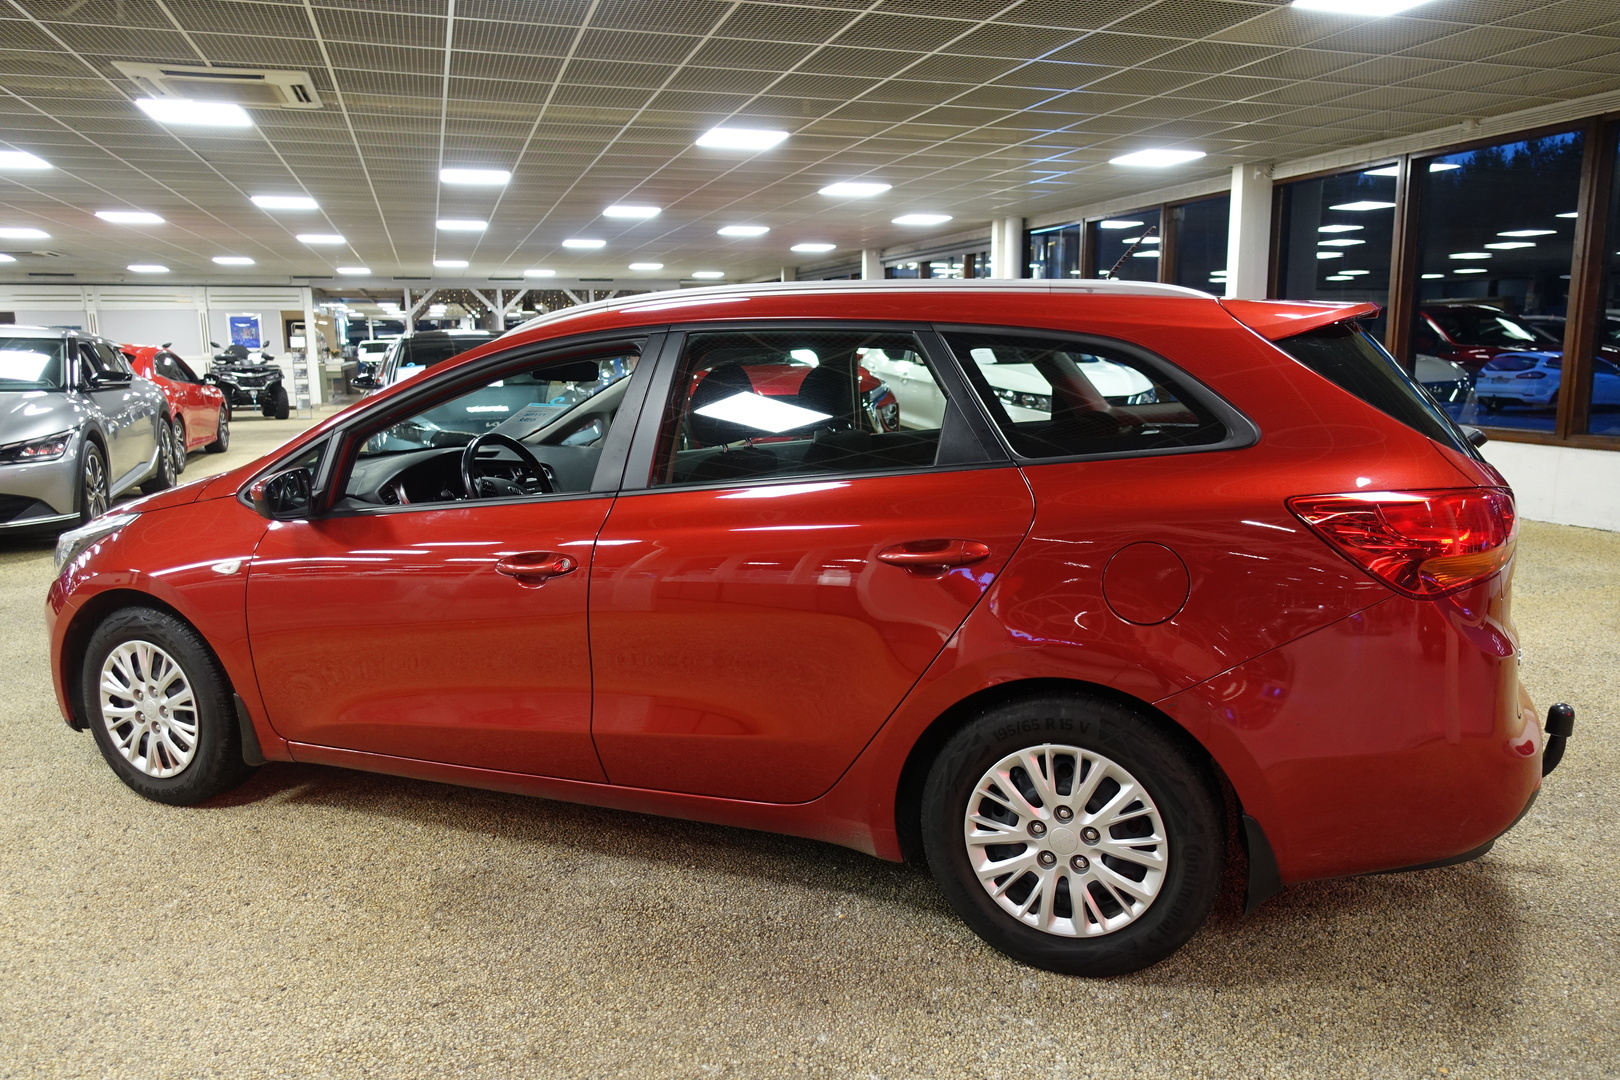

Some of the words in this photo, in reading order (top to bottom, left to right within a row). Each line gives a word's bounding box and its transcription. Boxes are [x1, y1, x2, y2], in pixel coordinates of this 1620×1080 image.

[992, 718, 1040, 742] 195/65
[1045, 717, 1056, 730] R
[1059, 717, 1074, 731] 15
[1079, 720, 1090, 734] V
